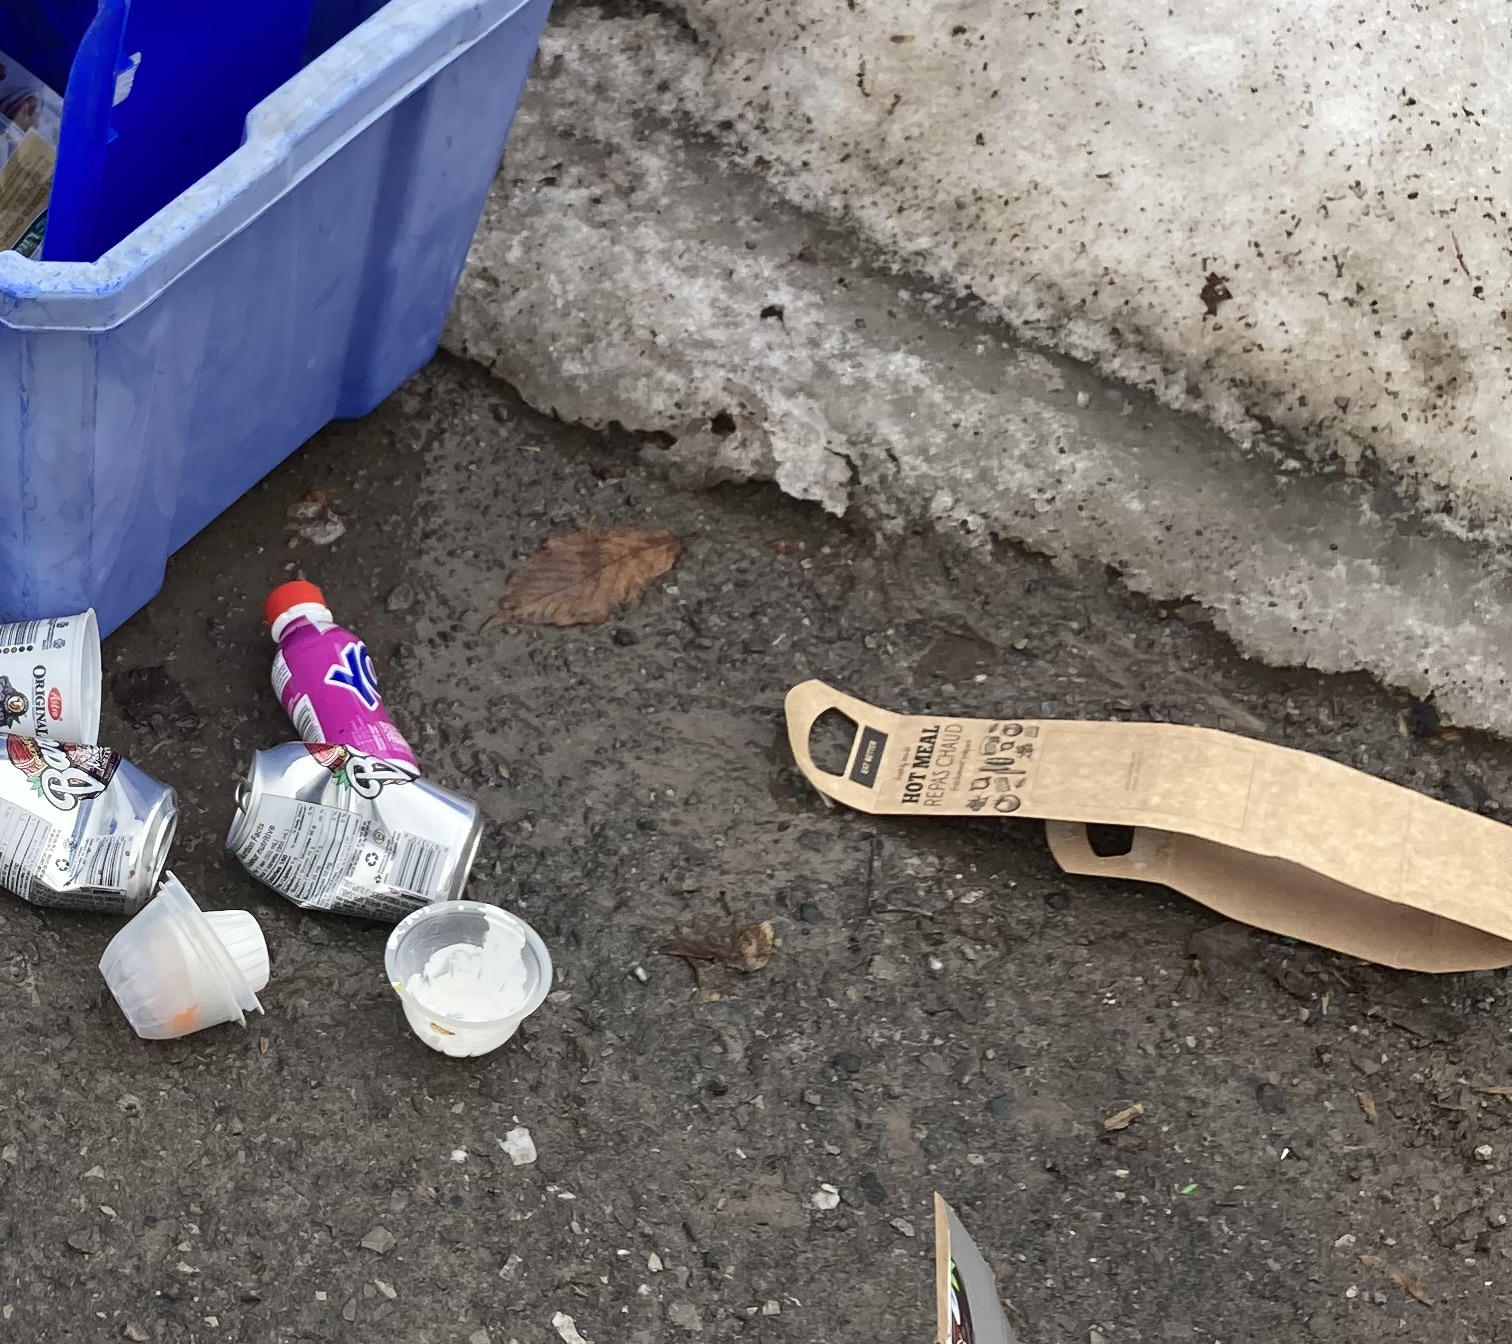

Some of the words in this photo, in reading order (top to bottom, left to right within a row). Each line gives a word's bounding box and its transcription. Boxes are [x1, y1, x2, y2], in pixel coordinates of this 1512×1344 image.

[33, 664, 49, 736] ORIGINAL
[913, 726, 940, 768] MEAL
[935, 725, 963, 765] CHAUD
[903, 771, 926, 803] HOT
[924, 771, 950, 806] REPAS
[251, 822, 265, 841] Facts
